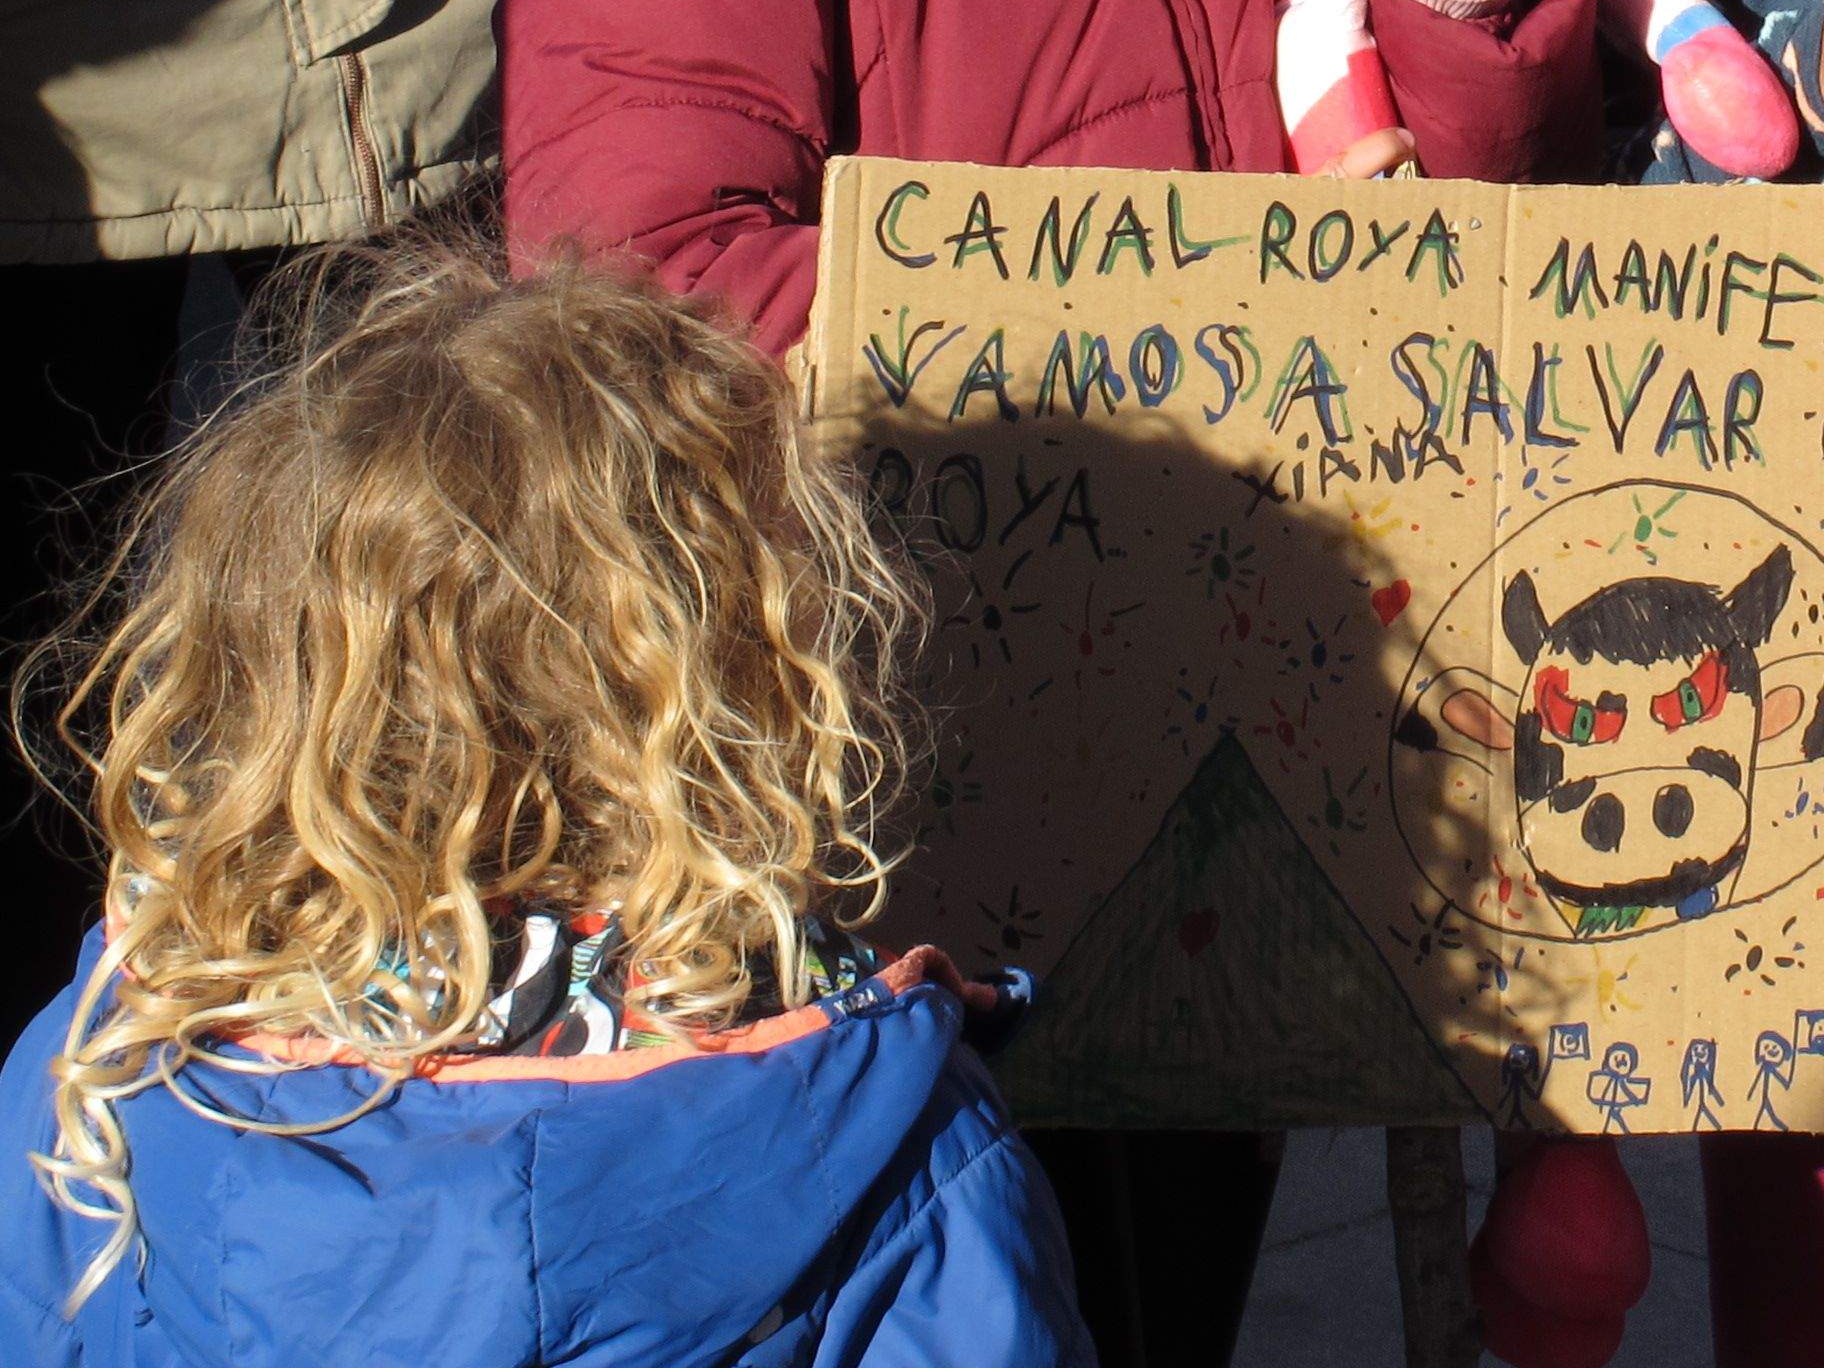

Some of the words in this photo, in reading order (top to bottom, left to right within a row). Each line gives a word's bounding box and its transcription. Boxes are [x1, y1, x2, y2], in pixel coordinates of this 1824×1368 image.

[875, 180, 1251, 287] CANAL
[1259, 200, 1465, 297] ROYA
[862, 305, 1263, 425] VAMOS
[1263, 335, 1354, 447] A
[1391, 331, 1767, 472] SALVAR
